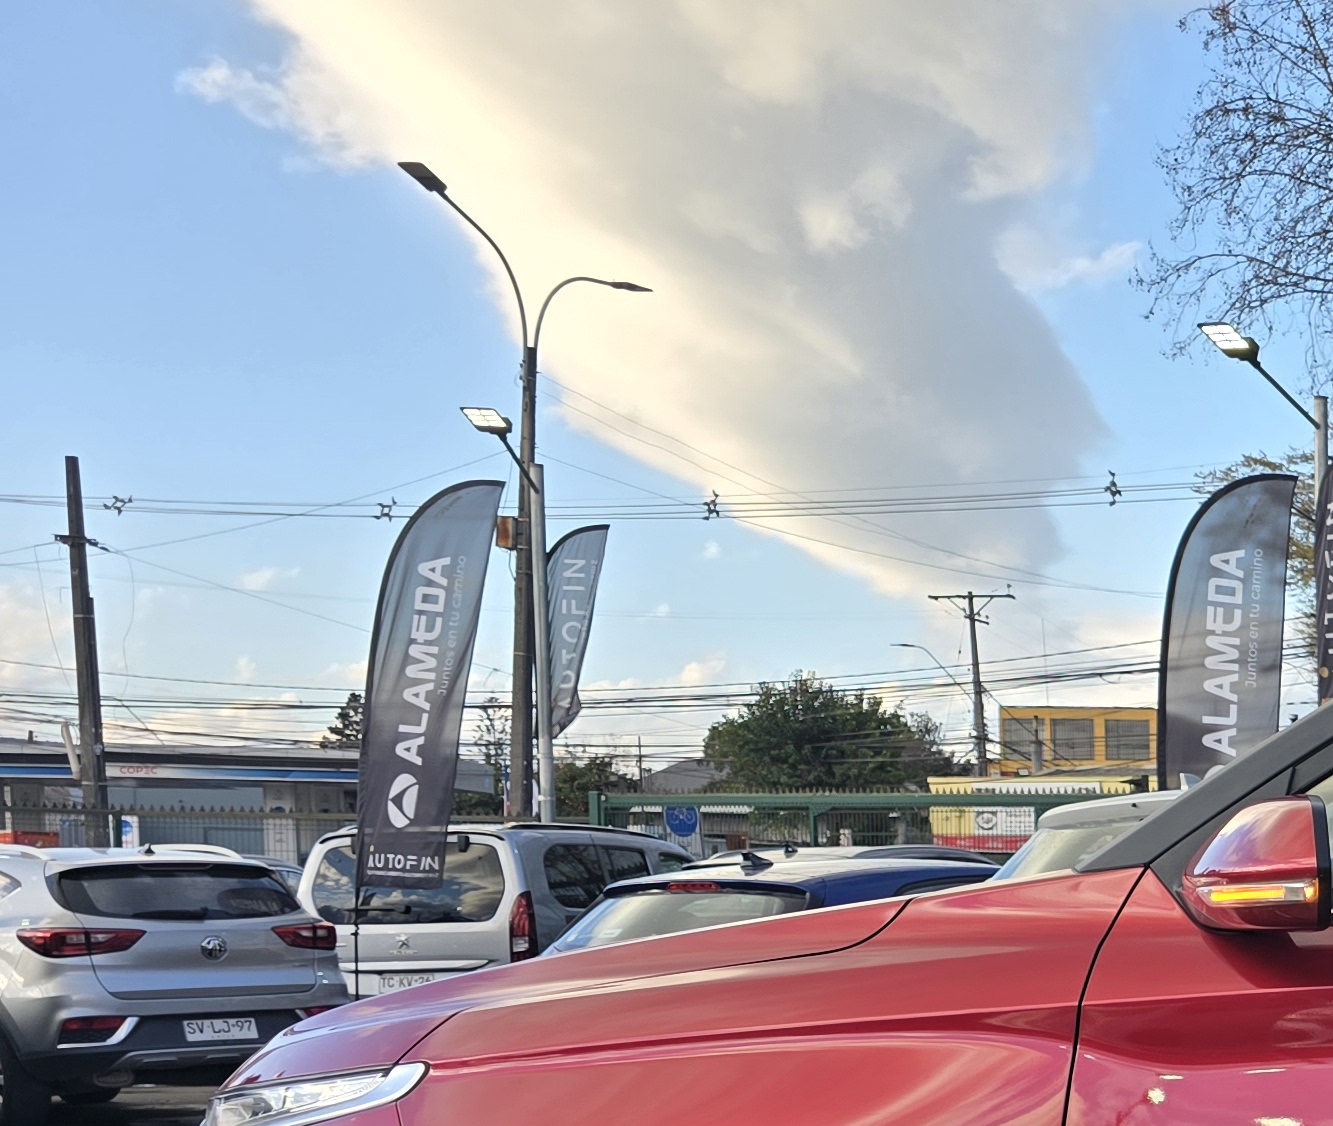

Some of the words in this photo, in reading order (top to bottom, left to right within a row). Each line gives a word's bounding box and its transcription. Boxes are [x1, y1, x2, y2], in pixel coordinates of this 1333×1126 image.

[452, 555, 467, 608] camino
[1250, 548, 1263, 600] camino
[448, 611, 460, 626] tu
[1248, 603, 1260, 618] tu
[1249, 621, 1259, 639] en
[395, 556, 451, 766] ALAMEDA
[447, 630, 458, 648] en
[1202, 549, 1246, 757] ALAMEDA
[437, 651, 455, 697] Juntos
[1244, 641, 1259, 688] Juntos
[367, 853, 440, 871] AUTOFIN
